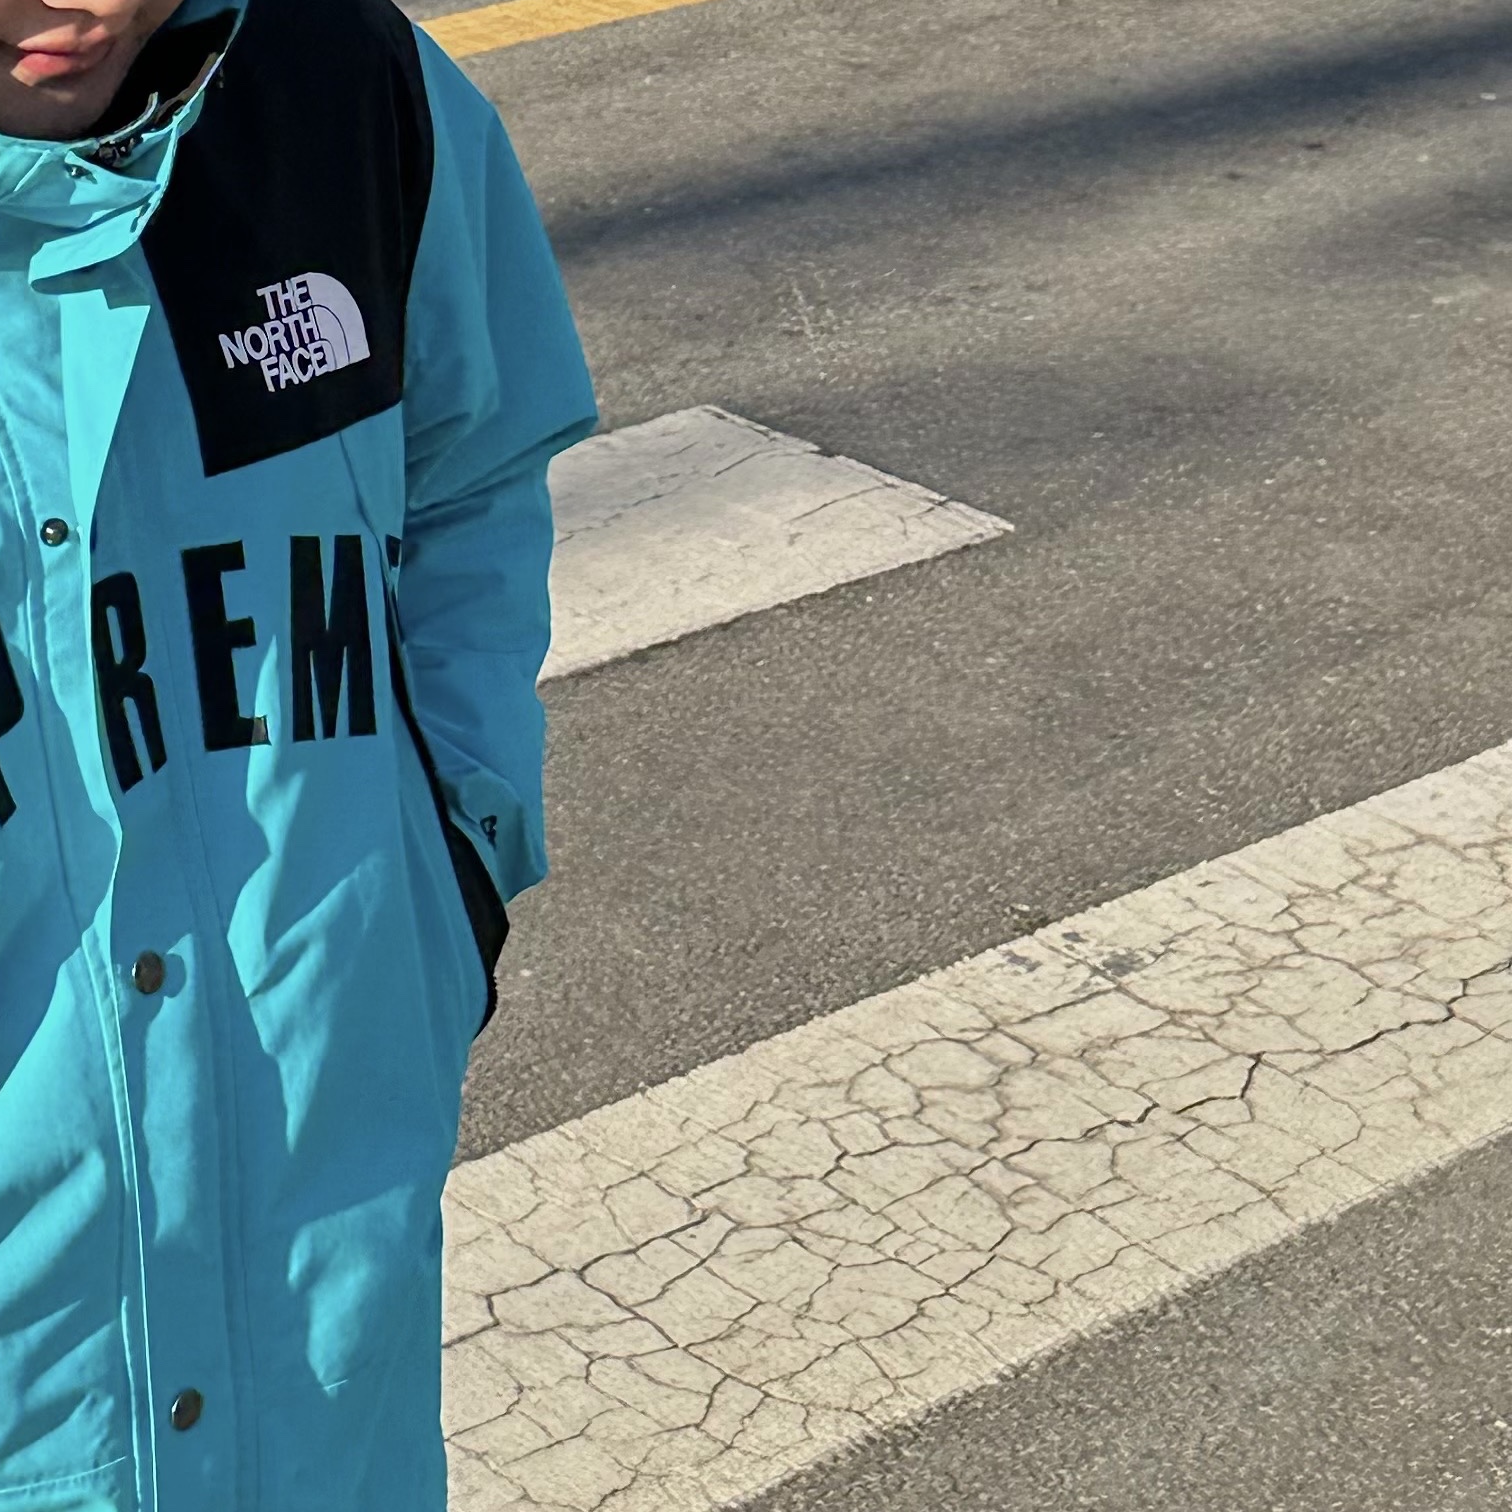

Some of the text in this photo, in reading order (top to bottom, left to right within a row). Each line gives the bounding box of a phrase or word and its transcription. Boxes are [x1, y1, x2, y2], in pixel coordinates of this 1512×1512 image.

[256, 276, 313, 320] THE
[218, 308, 320, 369] NORTH
[260, 342, 330, 393] FACE
